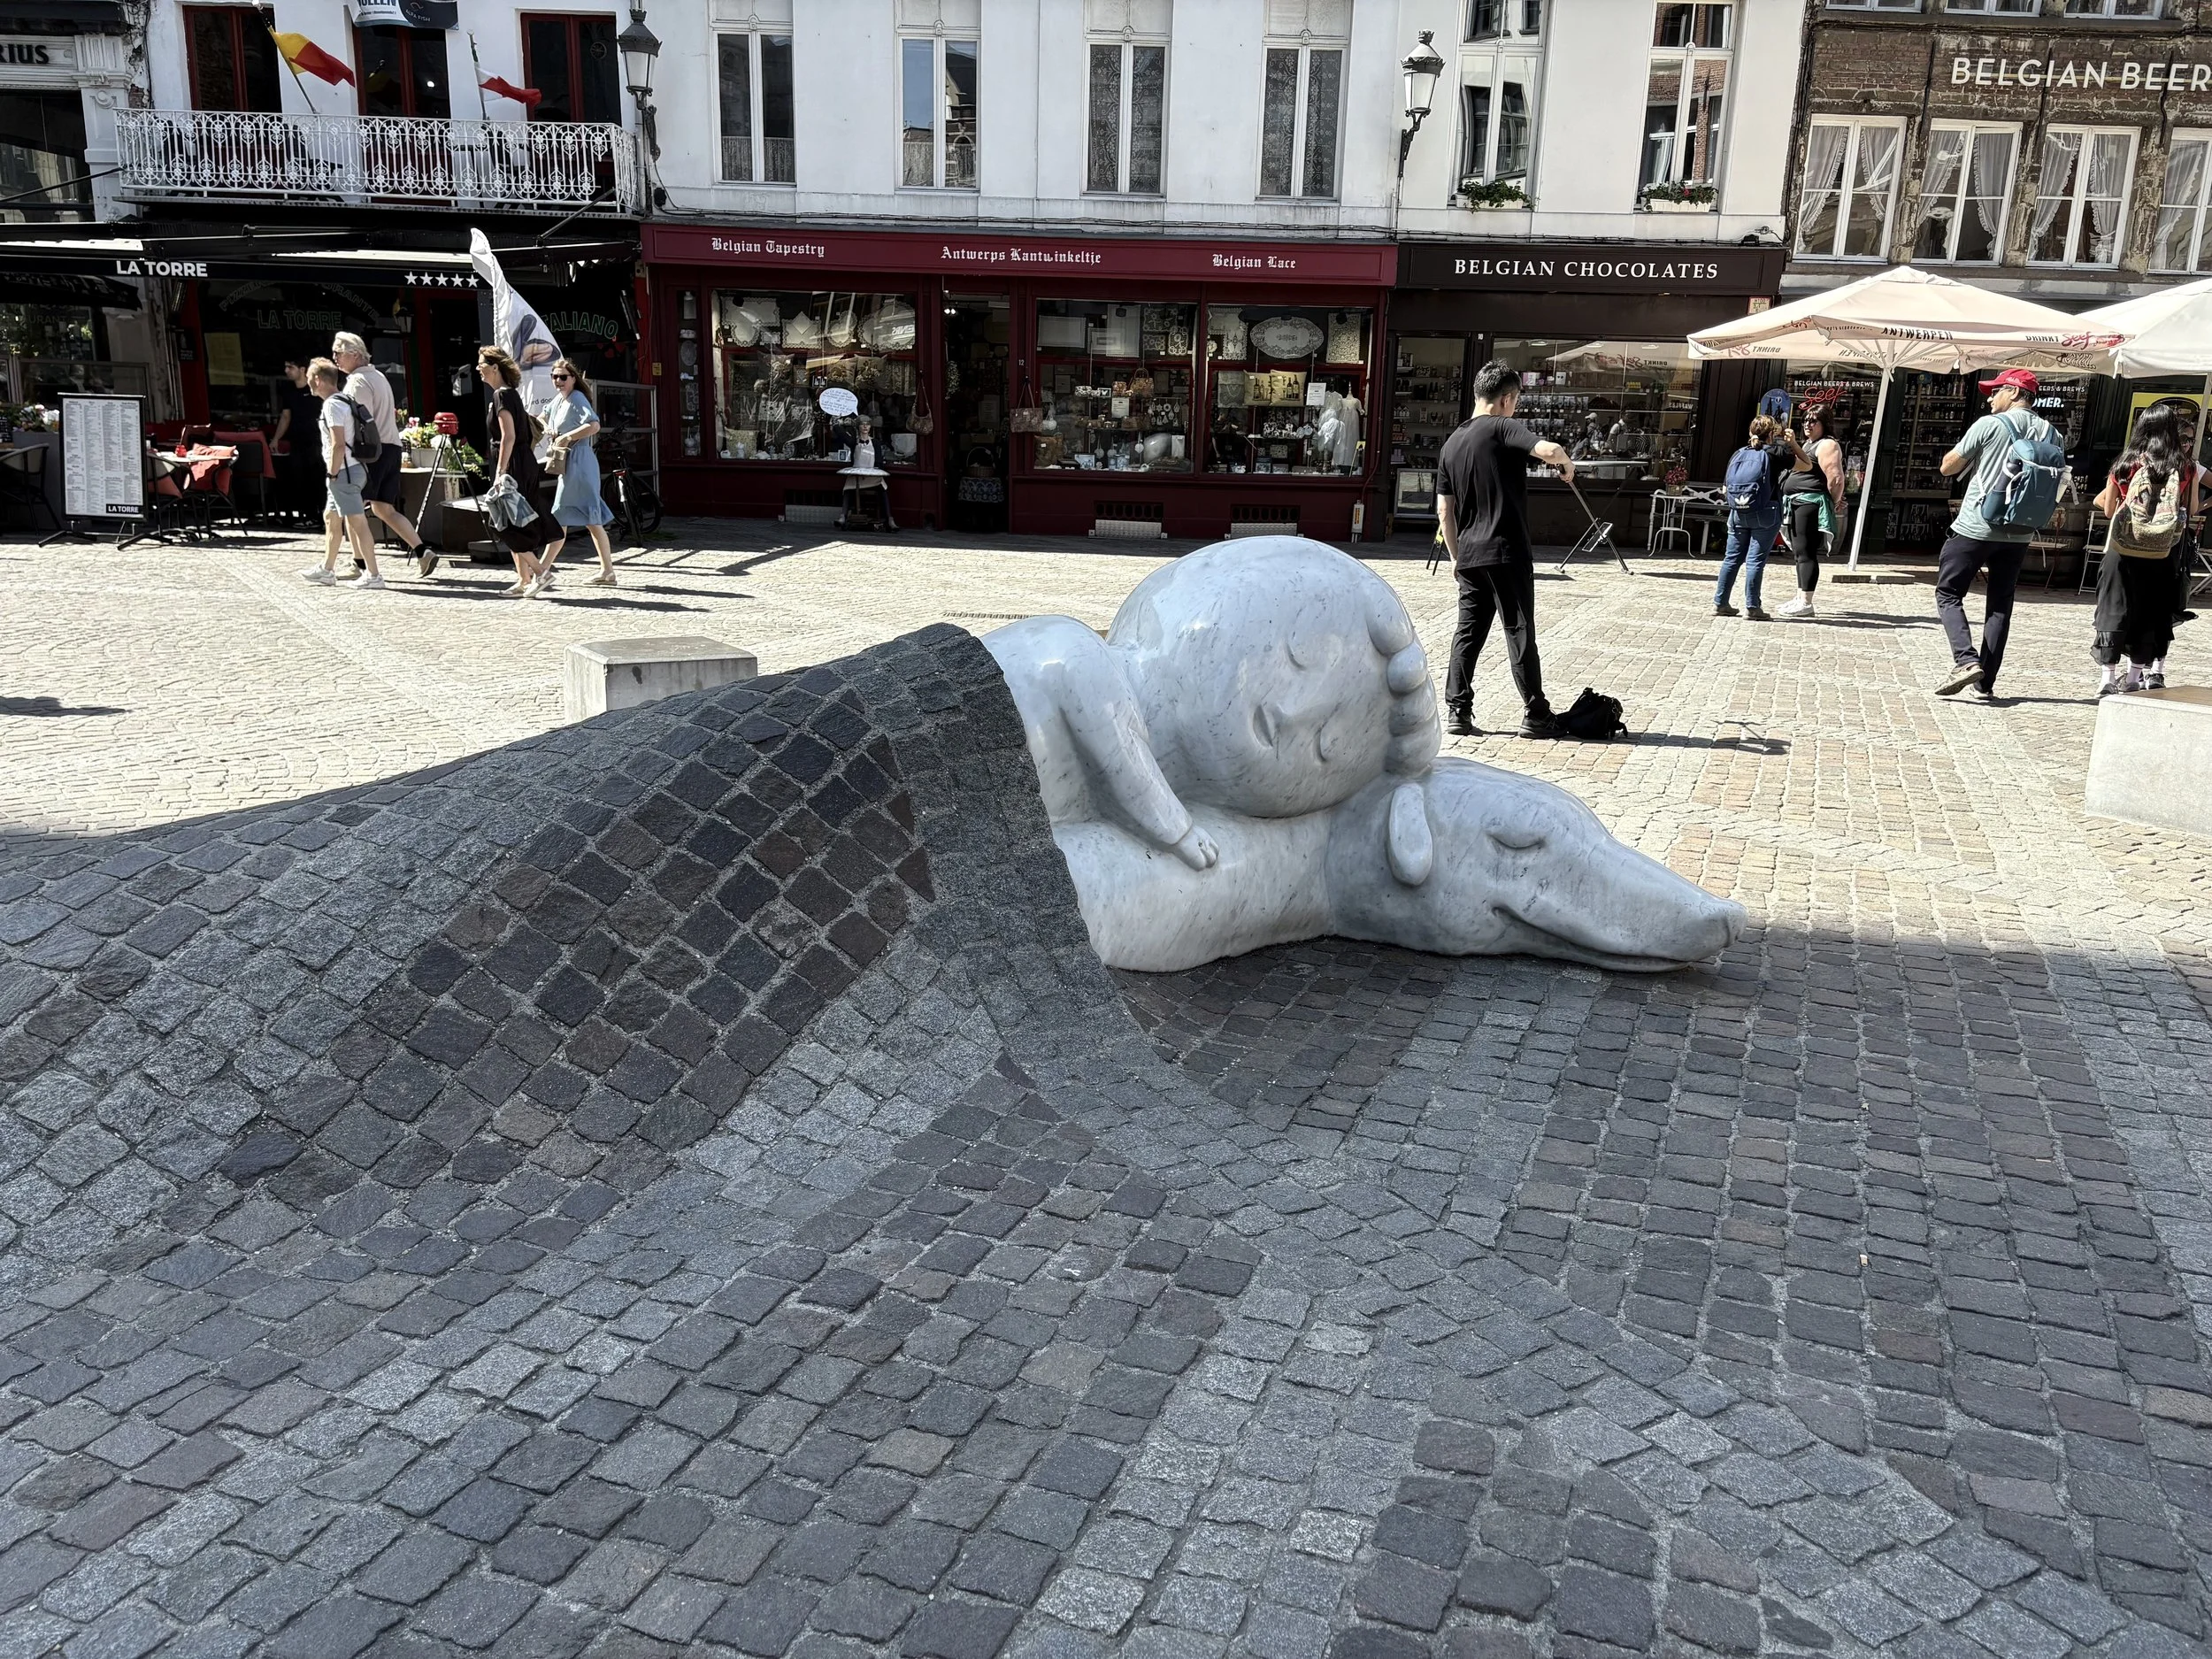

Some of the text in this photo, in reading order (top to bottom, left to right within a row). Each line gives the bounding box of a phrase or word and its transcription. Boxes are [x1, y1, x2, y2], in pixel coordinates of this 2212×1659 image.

[1951, 57, 2212, 92] BELGIAN BEER
[711, 237, 825, 257] Belgian Tapestry
[941, 246, 1102, 265] Antwerps Kantwinkeltje
[116, 260, 209, 277] LA TORRE
[1212, 254, 1296, 270] Belgian Lace
[1455, 258, 1718, 279] BELGIAN CHOCOLATES
[256, 309, 343, 331] LA TORRE
[1881, 326, 1954, 341] ANTWERPEN
